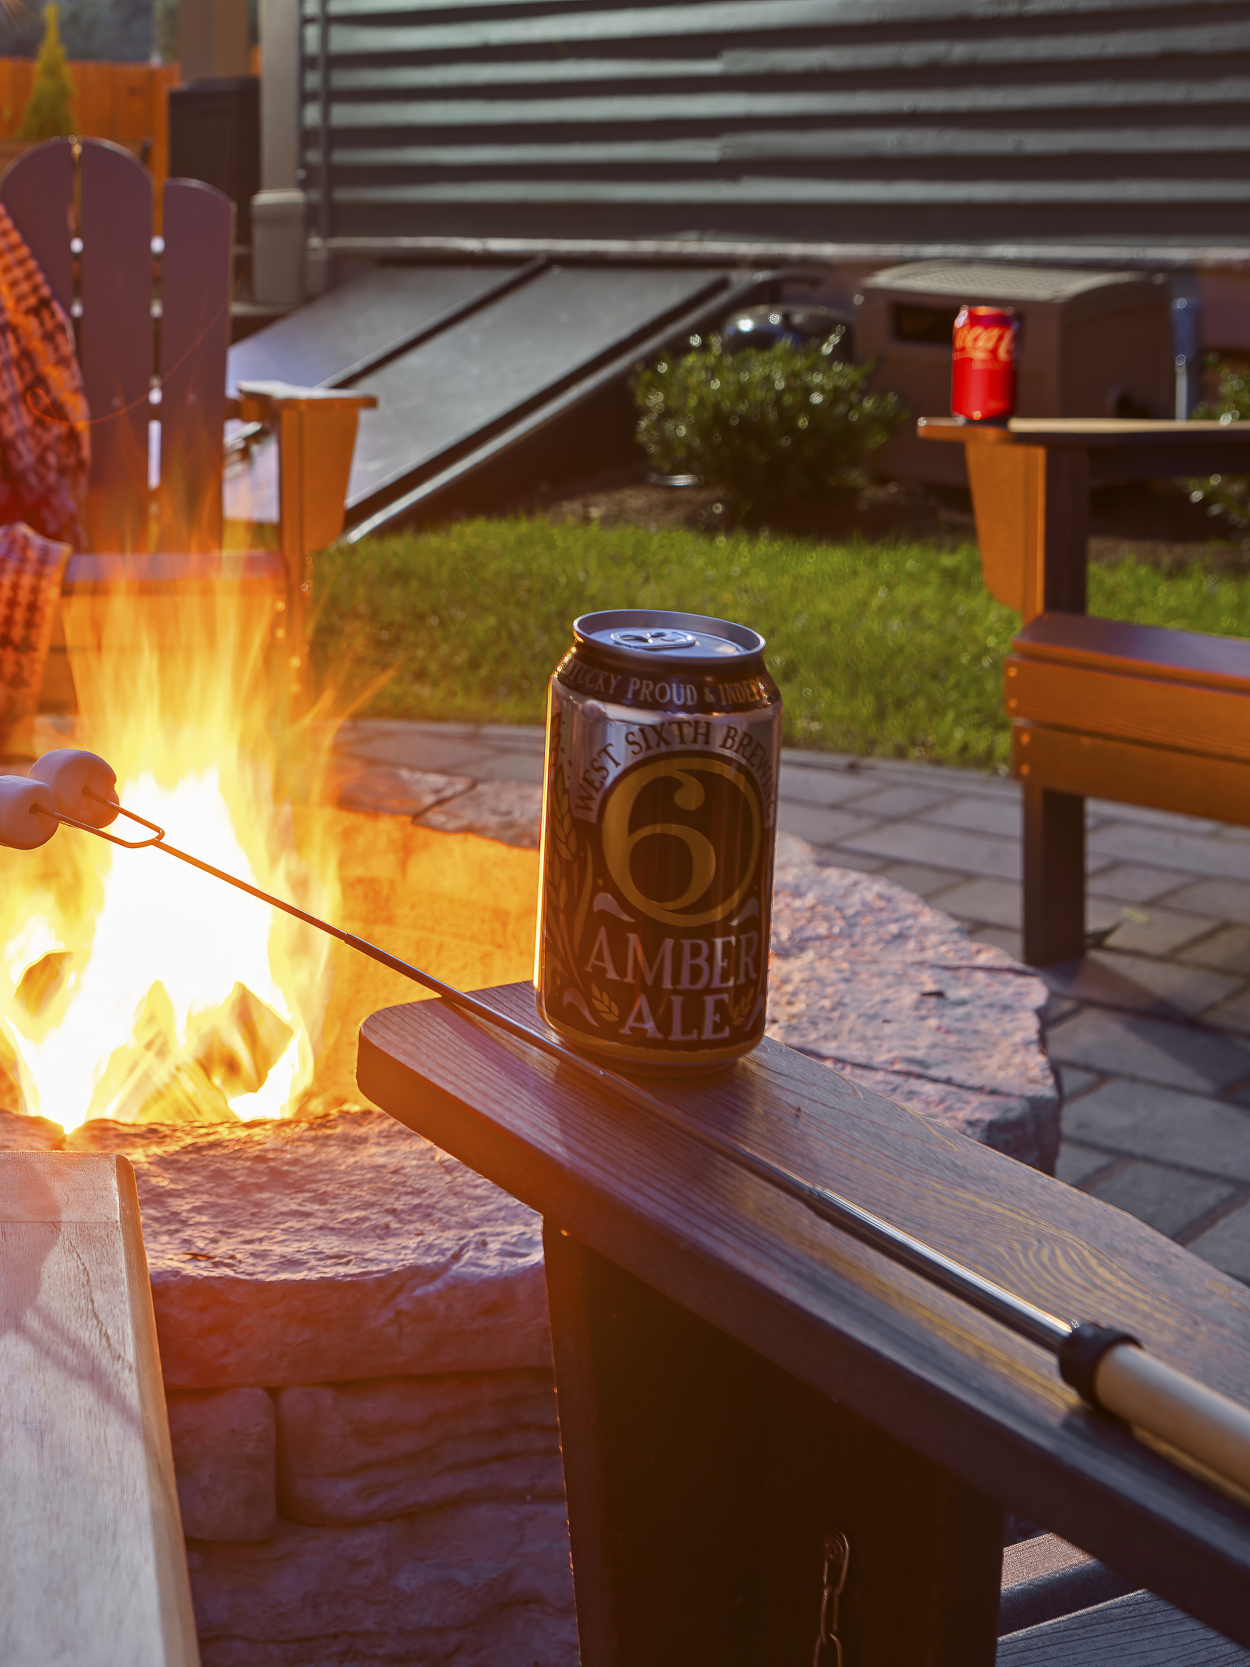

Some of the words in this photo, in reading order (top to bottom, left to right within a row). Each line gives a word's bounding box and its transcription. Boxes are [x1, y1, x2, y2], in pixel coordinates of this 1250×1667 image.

[626, 677, 698, 706] PROUD
[703, 685, 716, 704] &
[575, 743, 621, 814] WEST
[624, 720, 711, 755] SIXTH
[602, 757, 738, 921] 6
[584, 926, 760, 990] AMBER
[619, 992, 730, 1041] ALE
